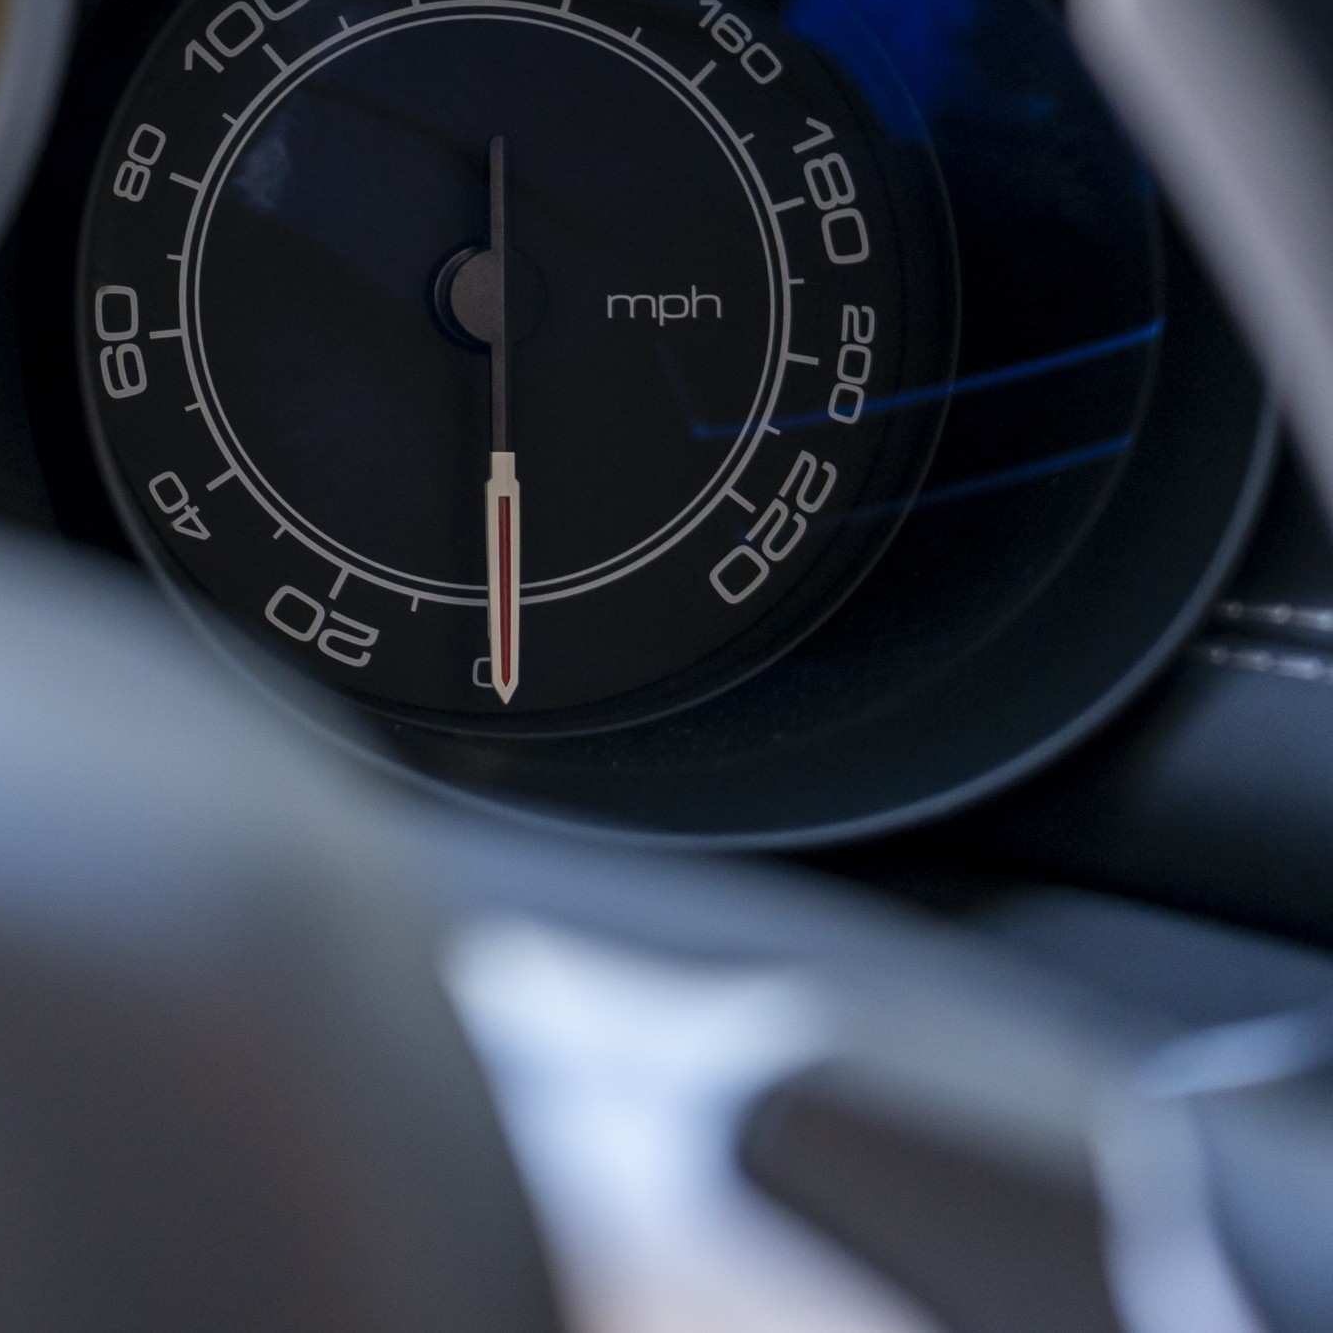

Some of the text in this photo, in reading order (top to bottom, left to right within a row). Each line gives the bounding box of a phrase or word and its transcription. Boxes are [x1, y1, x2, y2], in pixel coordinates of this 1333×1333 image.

[113, 123, 166, 202] 80
[792, 117, 869, 264] 180
[95, 285, 147, 399] 60
[607, 285, 721, 326] mph
[828, 305, 875, 423] 200
[148, 471, 211, 540] 40
[709, 450, 837, 604] 220
[264, 584, 379, 667] 20
